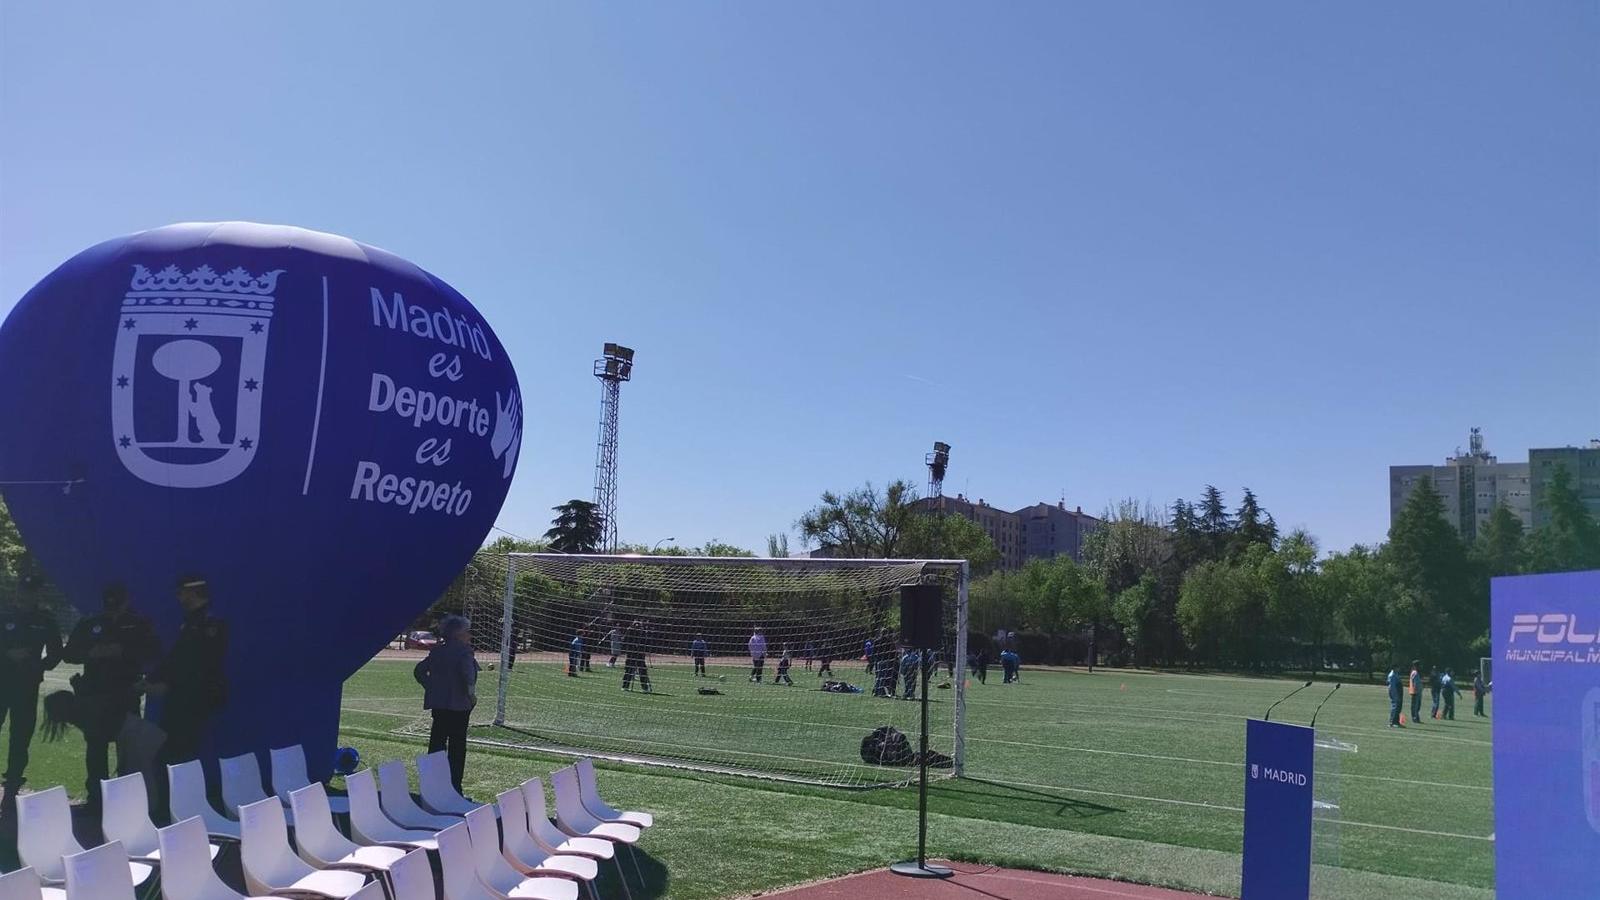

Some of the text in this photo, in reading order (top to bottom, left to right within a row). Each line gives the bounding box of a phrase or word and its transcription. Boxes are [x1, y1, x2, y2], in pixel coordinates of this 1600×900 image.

[370, 287, 492, 361] Madrid
[429, 352, 463, 381] es
[368, 373, 490, 436] Deporte
[415, 437, 452, 466] es
[350, 460, 472, 516] Respeto
[1509, 613, 1600, 643] POL
[1264, 767, 1306, 786] MADRID
